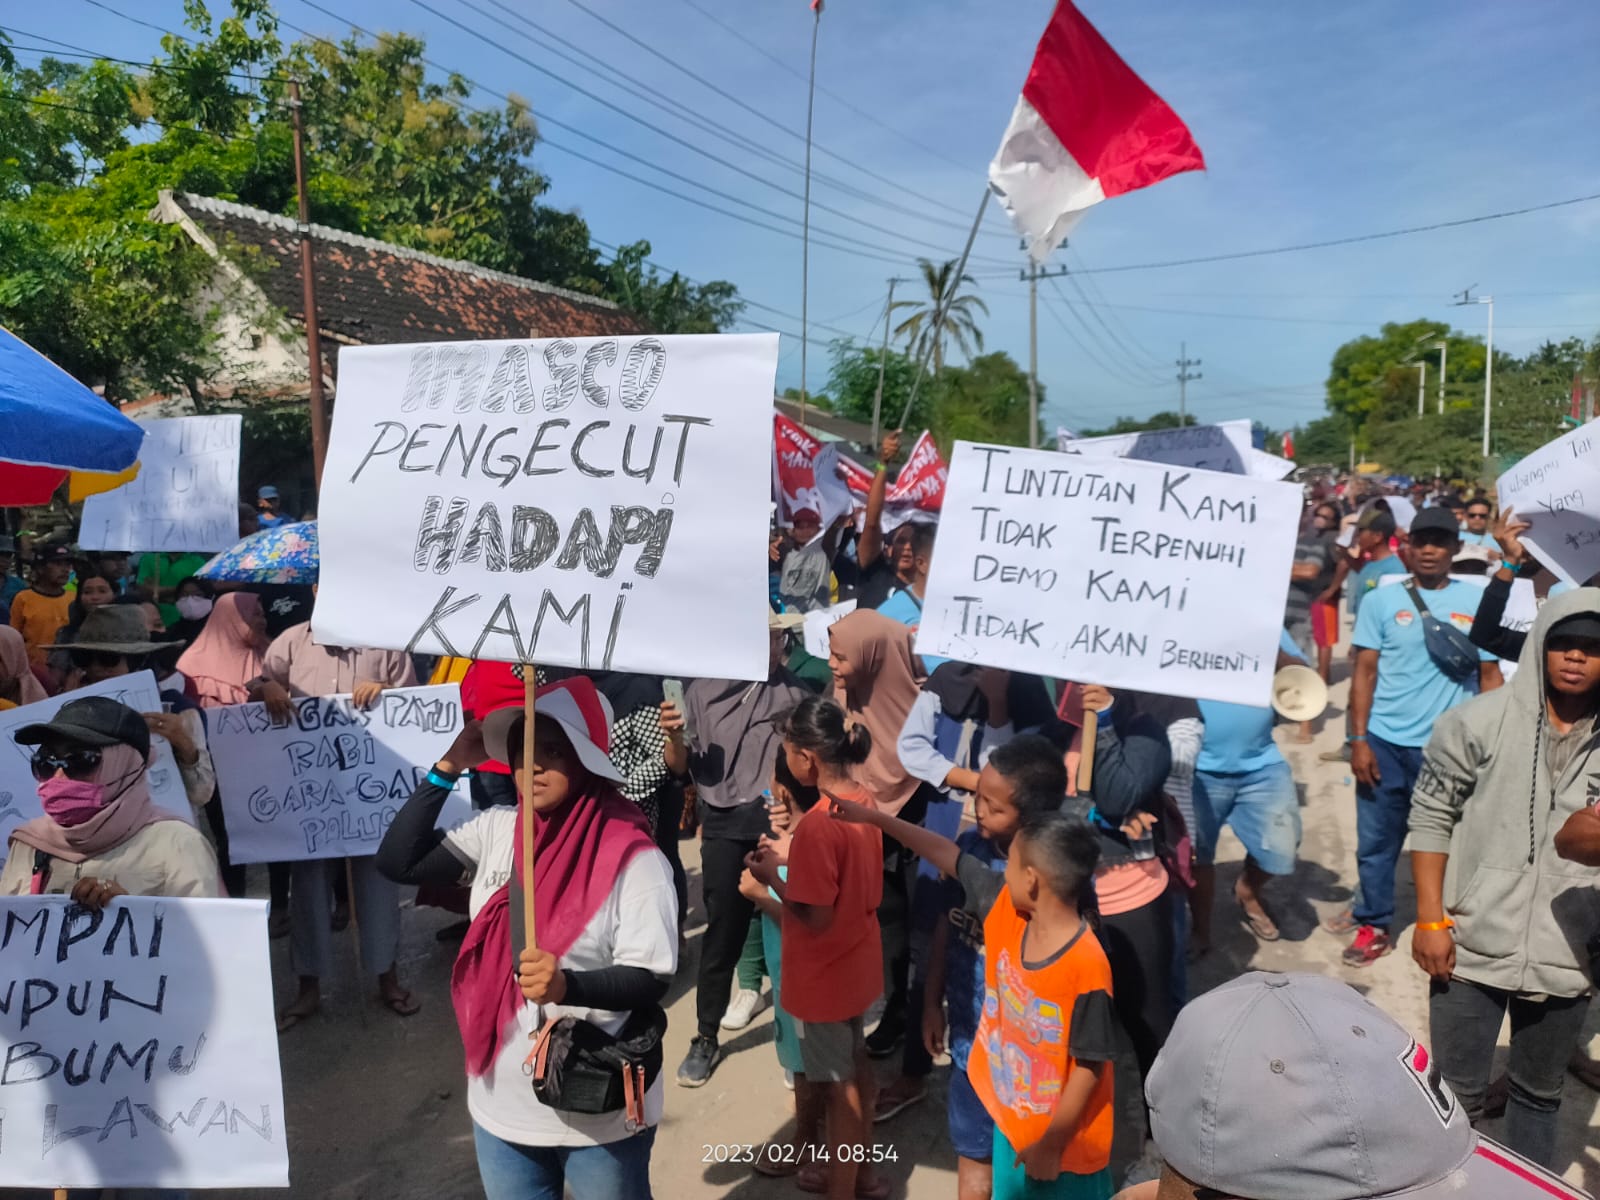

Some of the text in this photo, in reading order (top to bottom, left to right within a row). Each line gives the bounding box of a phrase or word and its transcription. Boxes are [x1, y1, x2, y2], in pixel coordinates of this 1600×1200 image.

[400, 337, 667, 414] IMASCO
[348, 413, 713, 488] PENGECUT
[972, 446, 1136, 505] TUNTUTAN
[413, 492, 675, 579] HADAPI
[971, 506, 1246, 568] TIDAK TERPENUHI
[973, 555, 1058, 592] DEMO
[404, 581, 635, 671] KAMI
[953, 595, 1261, 673] TIDAK AKAN BERHENTI
[283, 730, 376, 776] RABI
[248, 766, 460, 823] GARA-GA
[41, 1096, 275, 1160] LAWAN
